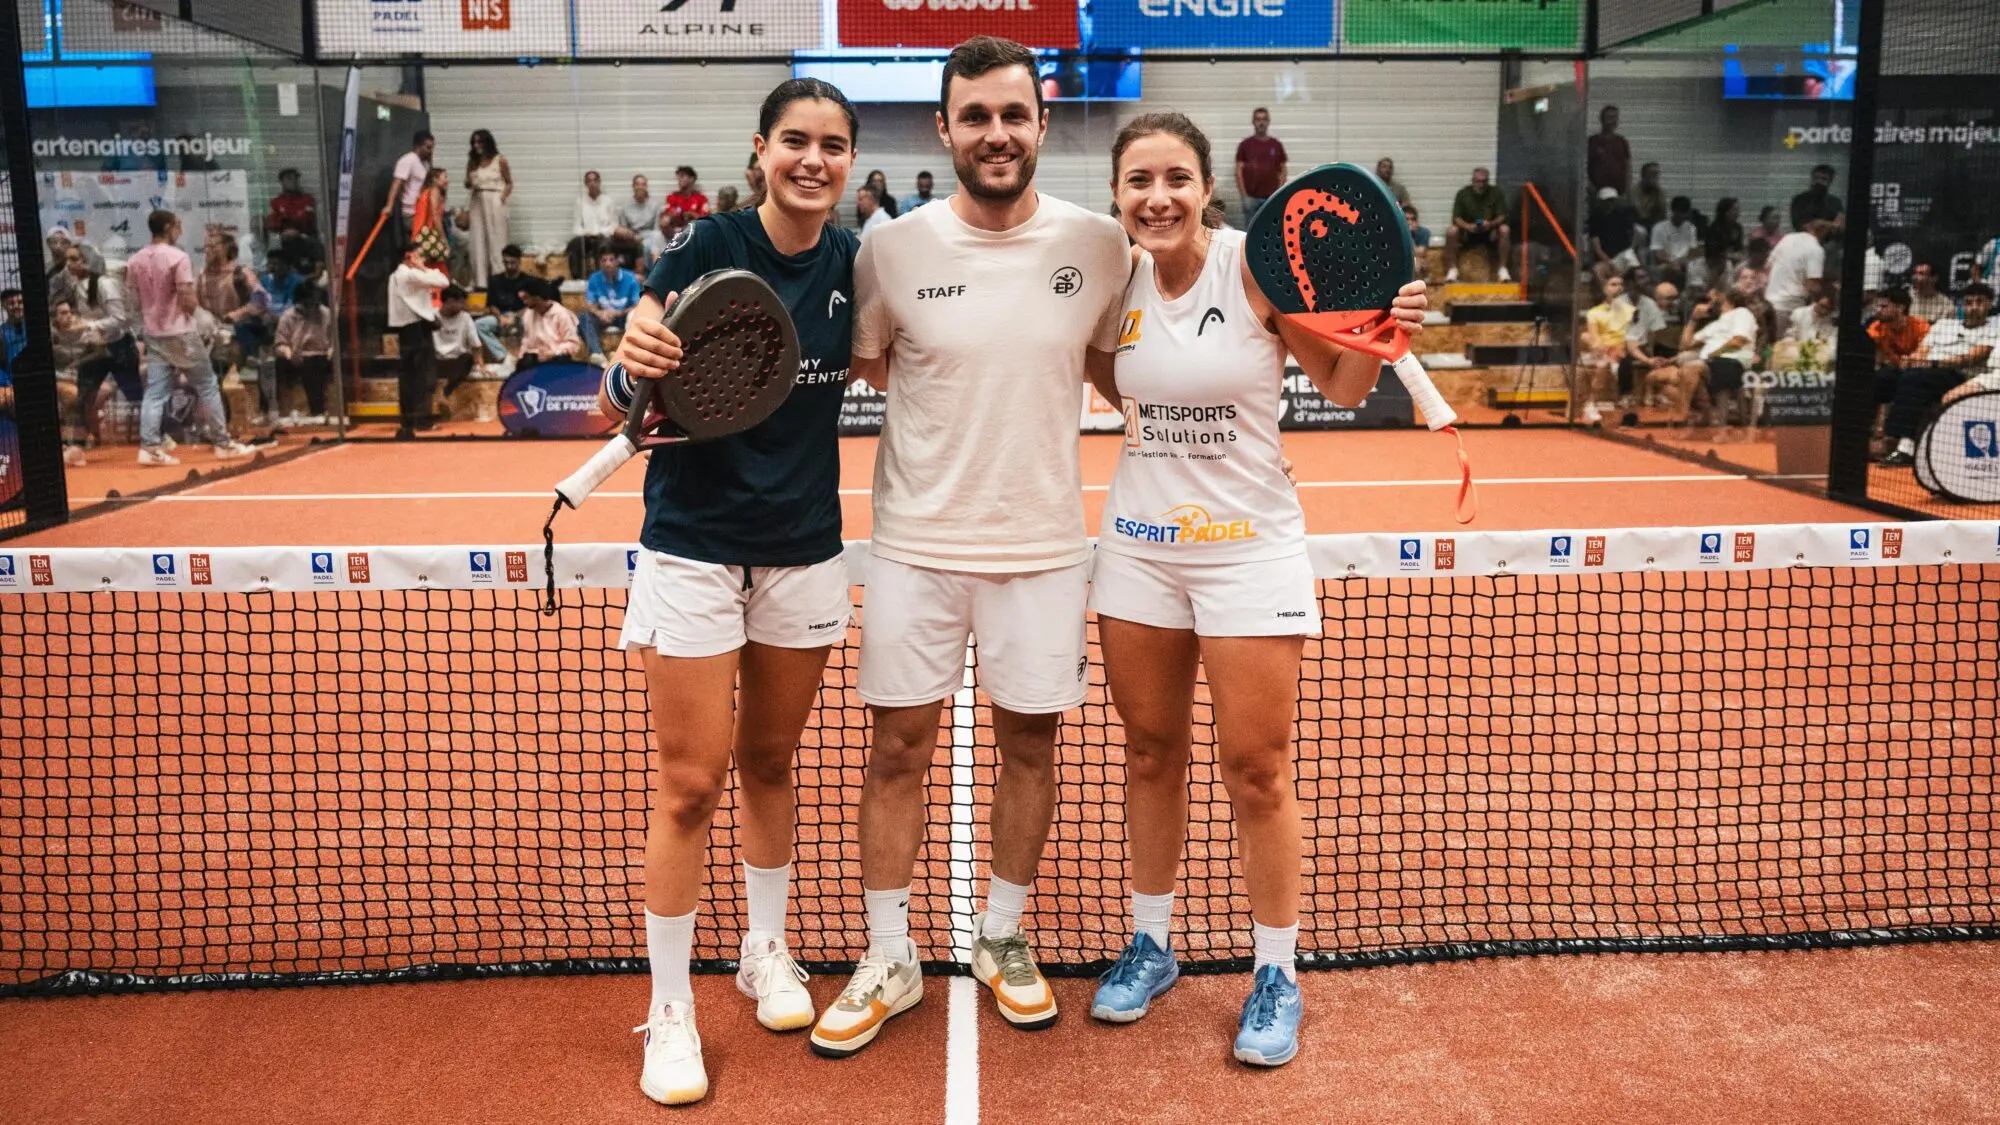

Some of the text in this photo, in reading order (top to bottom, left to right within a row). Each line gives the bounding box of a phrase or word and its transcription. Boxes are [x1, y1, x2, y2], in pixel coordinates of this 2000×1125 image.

[637, 23, 764, 35] ALPINE
[32, 133, 160, 157] artenaires
[917, 285, 967, 299] STAFF
[1341, 287, 1384, 321] RDICAL
[563, 401, 600, 411] FRANC
[841, 402, 859, 413] ne
[1293, 396, 1321, 410] Une
[1138, 403, 1237, 422] METISPORTS
[1293, 410, 1356, 422] d'avance
[1143, 425, 1237, 445] Solutions
[1188, 453, 1227, 461] Formation
[1737, 536, 1752, 545] TEN
[1885, 531, 1900, 541] TEN
[1437, 542, 1452, 551] TEN
[1588, 540, 1603, 549] TEN
[1736, 550, 1751, 559] NIS
[1884, 545, 1898, 555] NIS
[192, 557, 207, 567] TEN
[350, 556, 366, 566] TEN
[508, 555, 523, 565] TEN
[1438, 557, 1452, 566] NIS
[1587, 553, 1601, 563] NIS
[32, 559, 48, 568] TEN
[34, 573, 50, 583] NIS
[194, 572, 209, 582] NIS
[352, 570, 367, 580] NIS
[510, 569, 525, 579] NIS
[808, 620, 839, 630] HEAD
